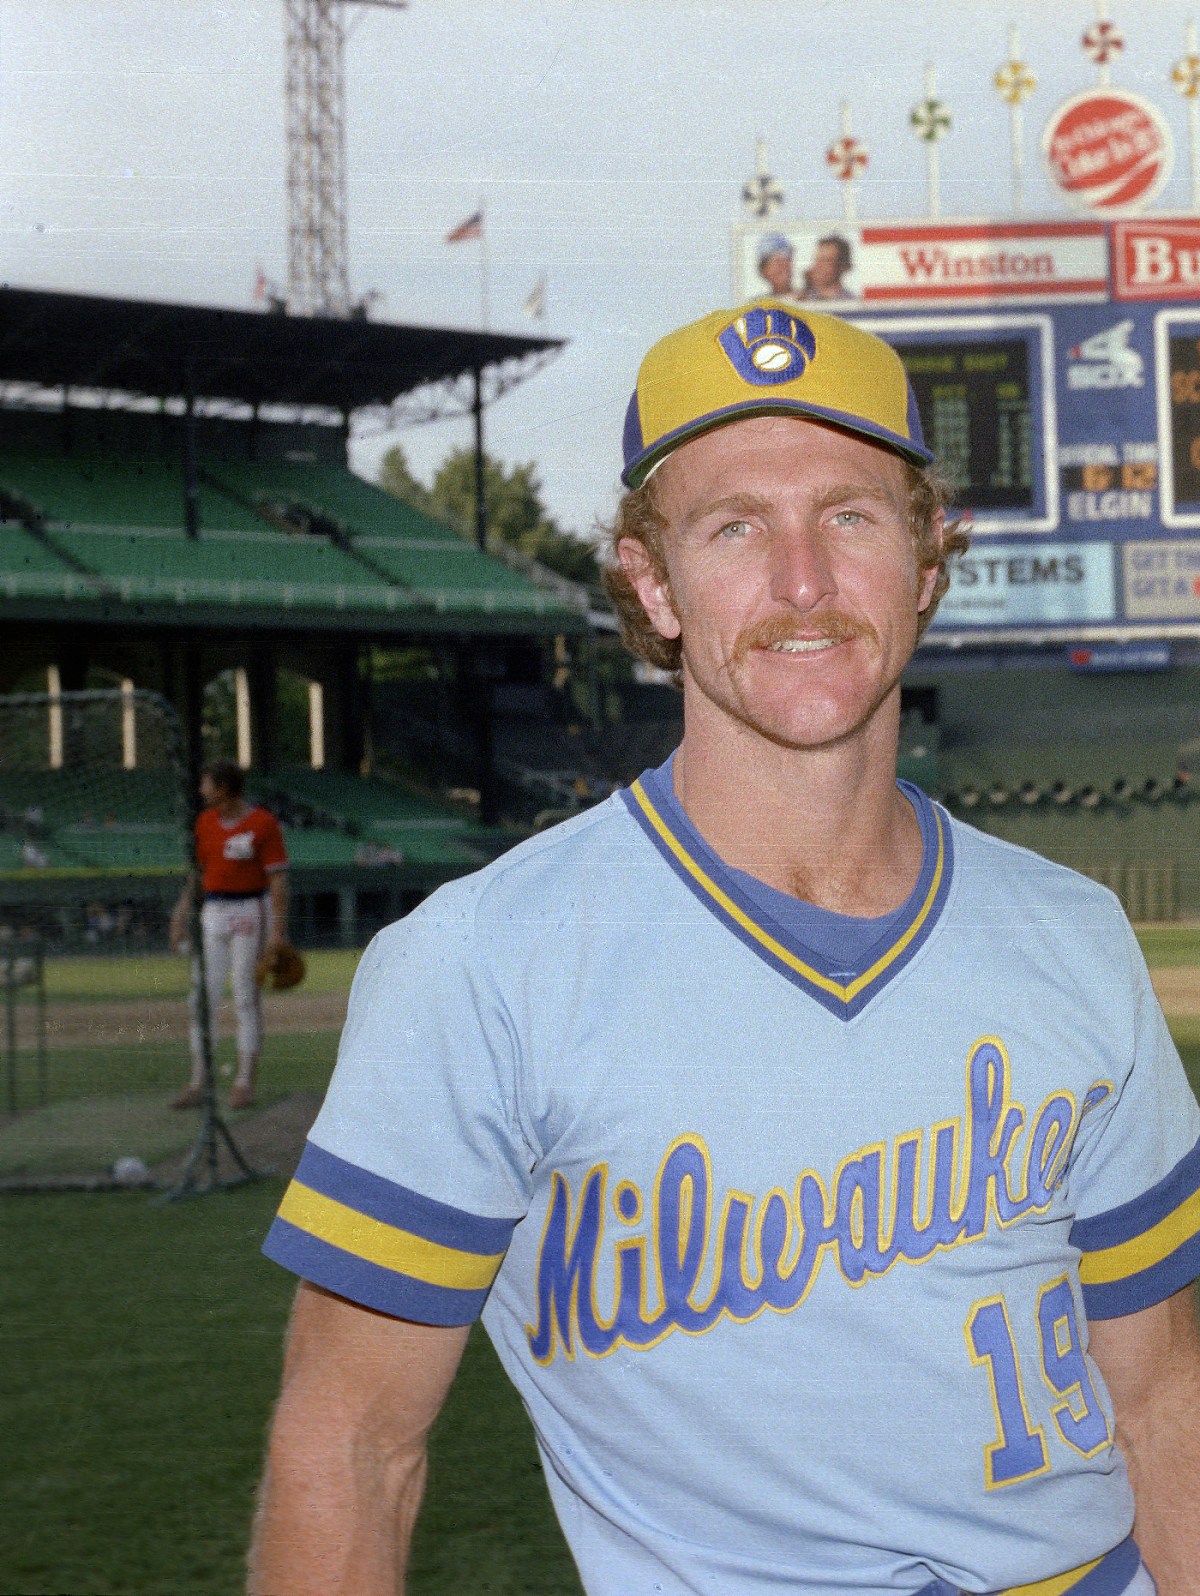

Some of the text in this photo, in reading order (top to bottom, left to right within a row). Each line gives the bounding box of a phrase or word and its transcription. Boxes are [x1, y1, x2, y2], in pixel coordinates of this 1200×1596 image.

[900, 249, 1055, 278] Winston
[1068, 491, 1152, 521] ELGIN
[963, 1274, 1116, 1492] 19
